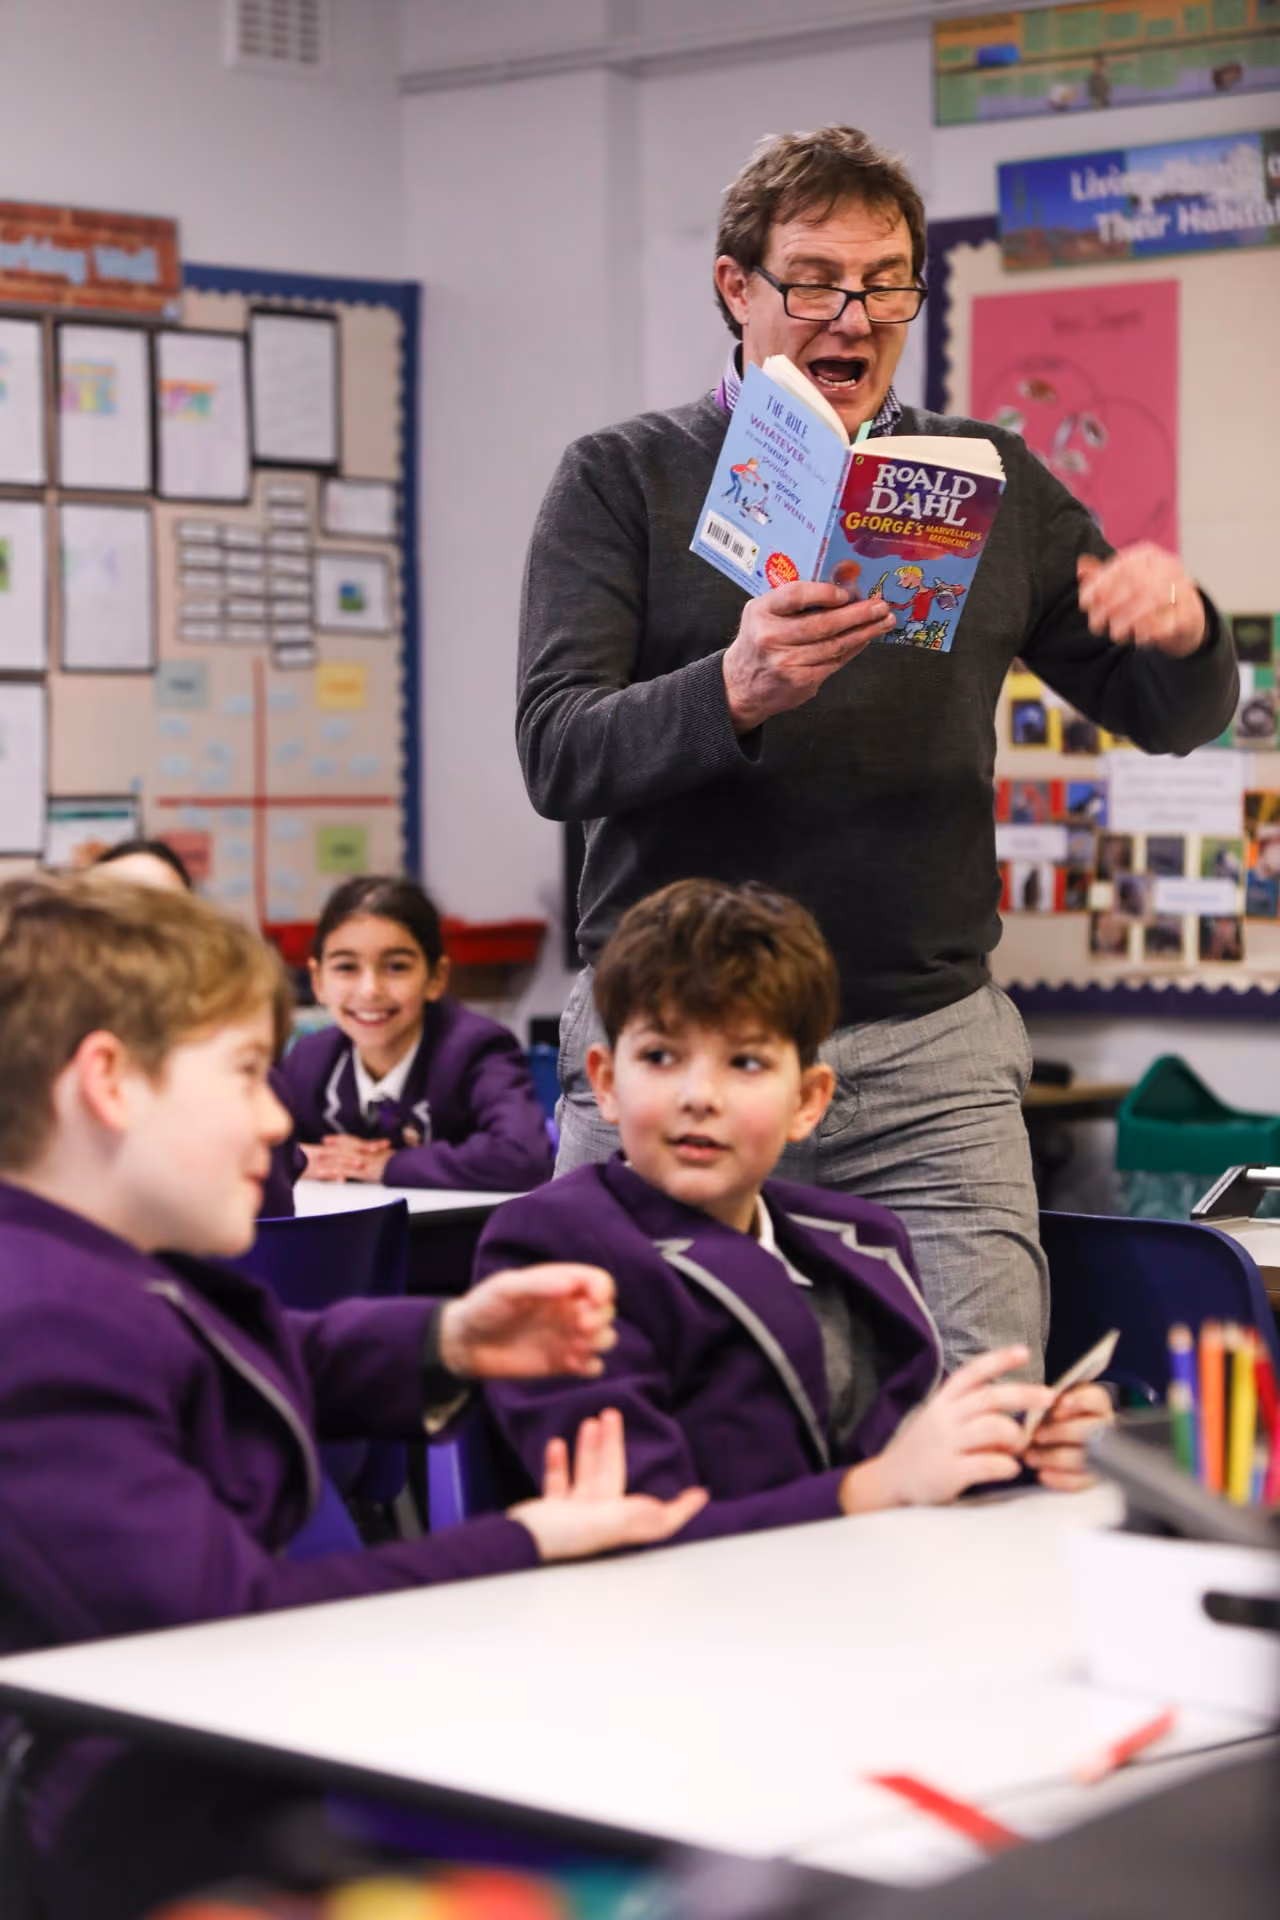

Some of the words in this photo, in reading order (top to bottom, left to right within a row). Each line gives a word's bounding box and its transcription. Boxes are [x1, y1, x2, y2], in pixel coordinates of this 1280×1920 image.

[767, 393, 784, 419] THE
[785, 411, 808, 438] RULE
[751, 413, 805, 465] WHATEVER
[872, 464, 977, 499] ROALD
[866, 487, 967, 526] DAHL
[845, 512, 925, 536] GEORGE'S
[925, 525, 982, 541] MARVELLOUS
[929, 534, 970, 549] MEDICINE
